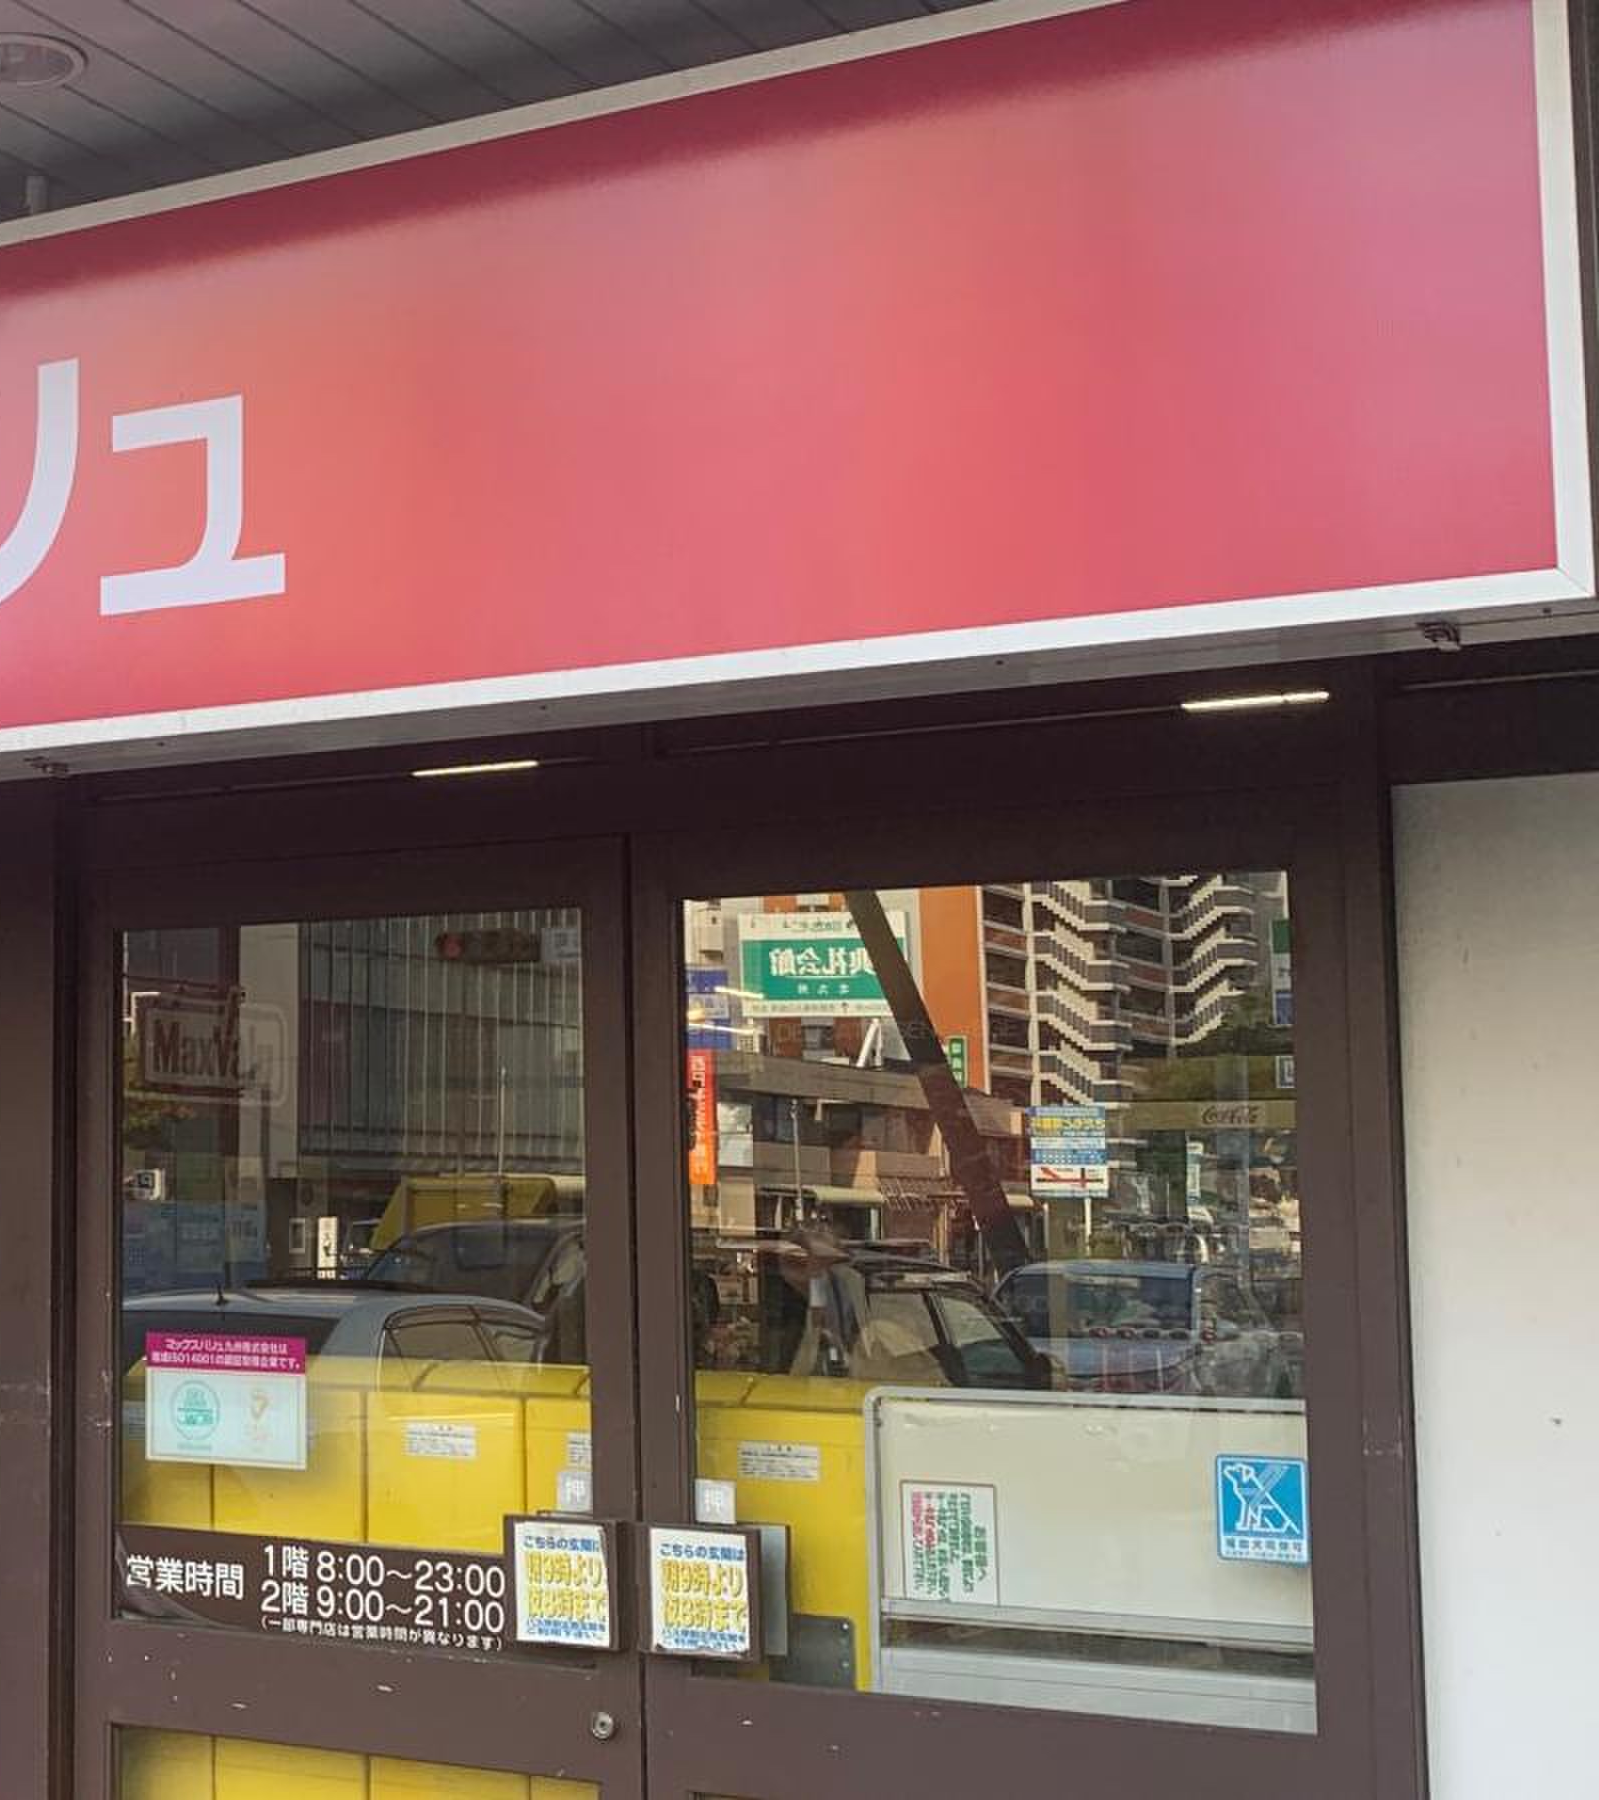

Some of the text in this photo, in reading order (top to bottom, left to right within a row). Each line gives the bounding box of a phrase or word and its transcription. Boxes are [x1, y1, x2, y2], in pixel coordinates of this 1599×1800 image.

[263, 1544, 310, 1580] 1階
[659, 1543, 745, 1561] こちらの玄関は
[126, 1553, 244, 1600] 営業時間
[261, 1580, 310, 1616] 2階
